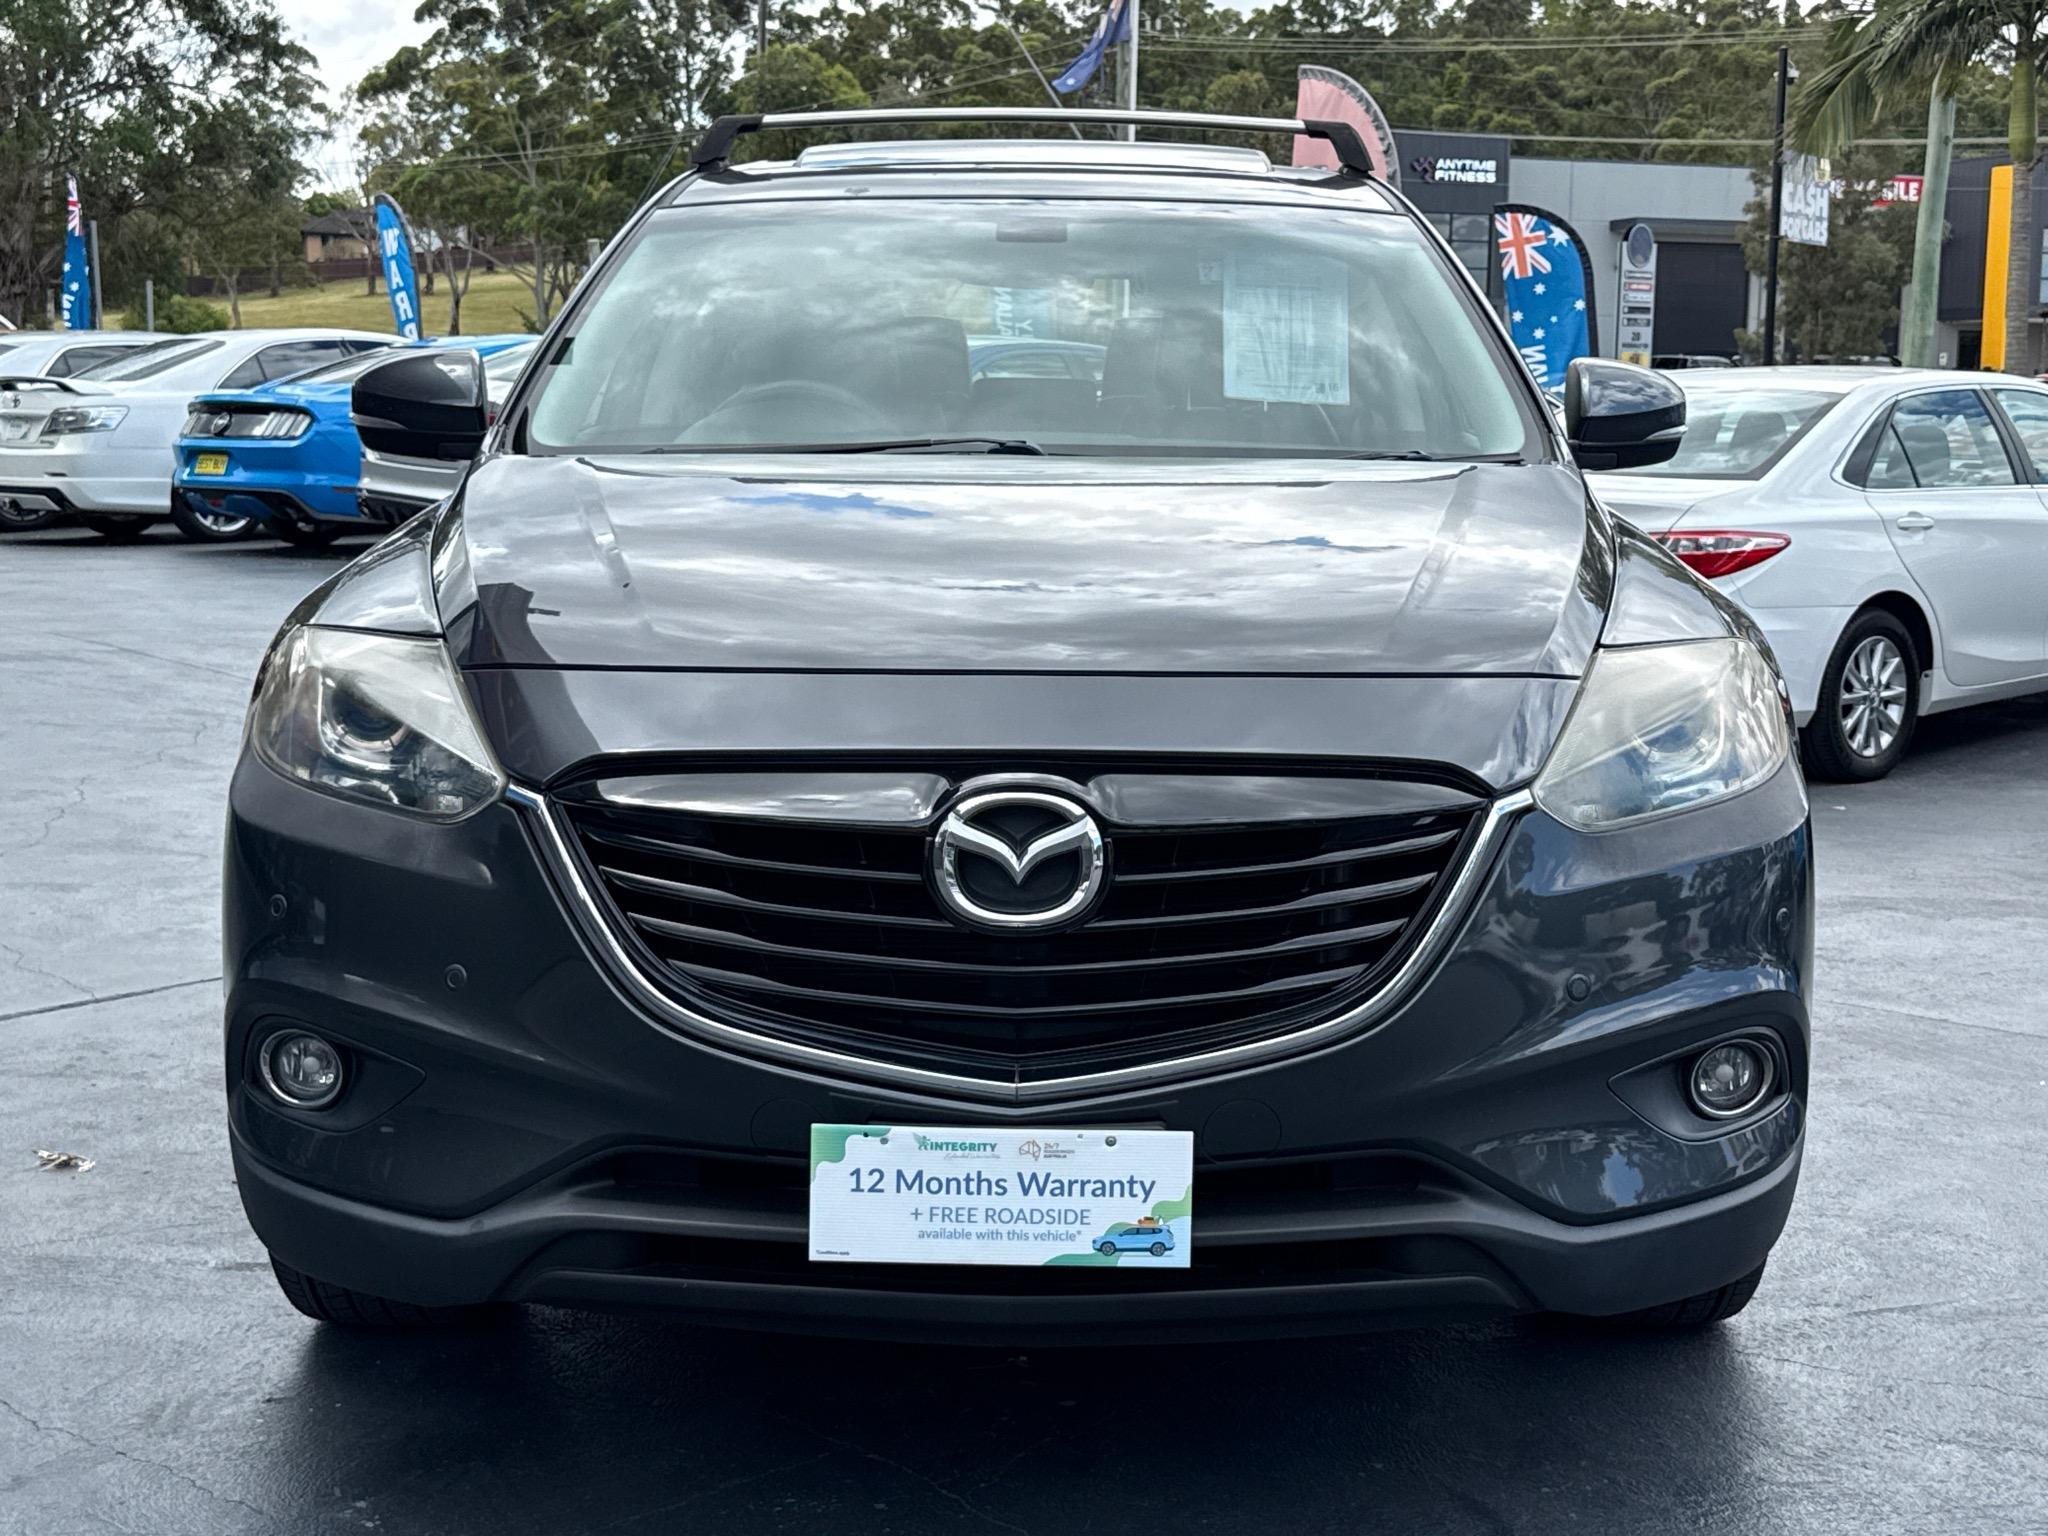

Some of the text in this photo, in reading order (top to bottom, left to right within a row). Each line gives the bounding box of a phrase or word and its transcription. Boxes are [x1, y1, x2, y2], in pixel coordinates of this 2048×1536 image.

[1436, 158, 1497, 171] ANYTIME
[1435, 170, 1497, 183] FITNESS
[1781, 182, 1829, 218] CASH
[929, 1141, 998, 1152] INTEGRITY
[849, 1167, 1156, 1204] 12 Months Warranty
[910, 1206, 1092, 1226] + FREE ROADSIDE
[918, 1227, 973, 1241] available
[976, 1229, 1003, 1241] with
[1007, 1229, 1030, 1242] this
